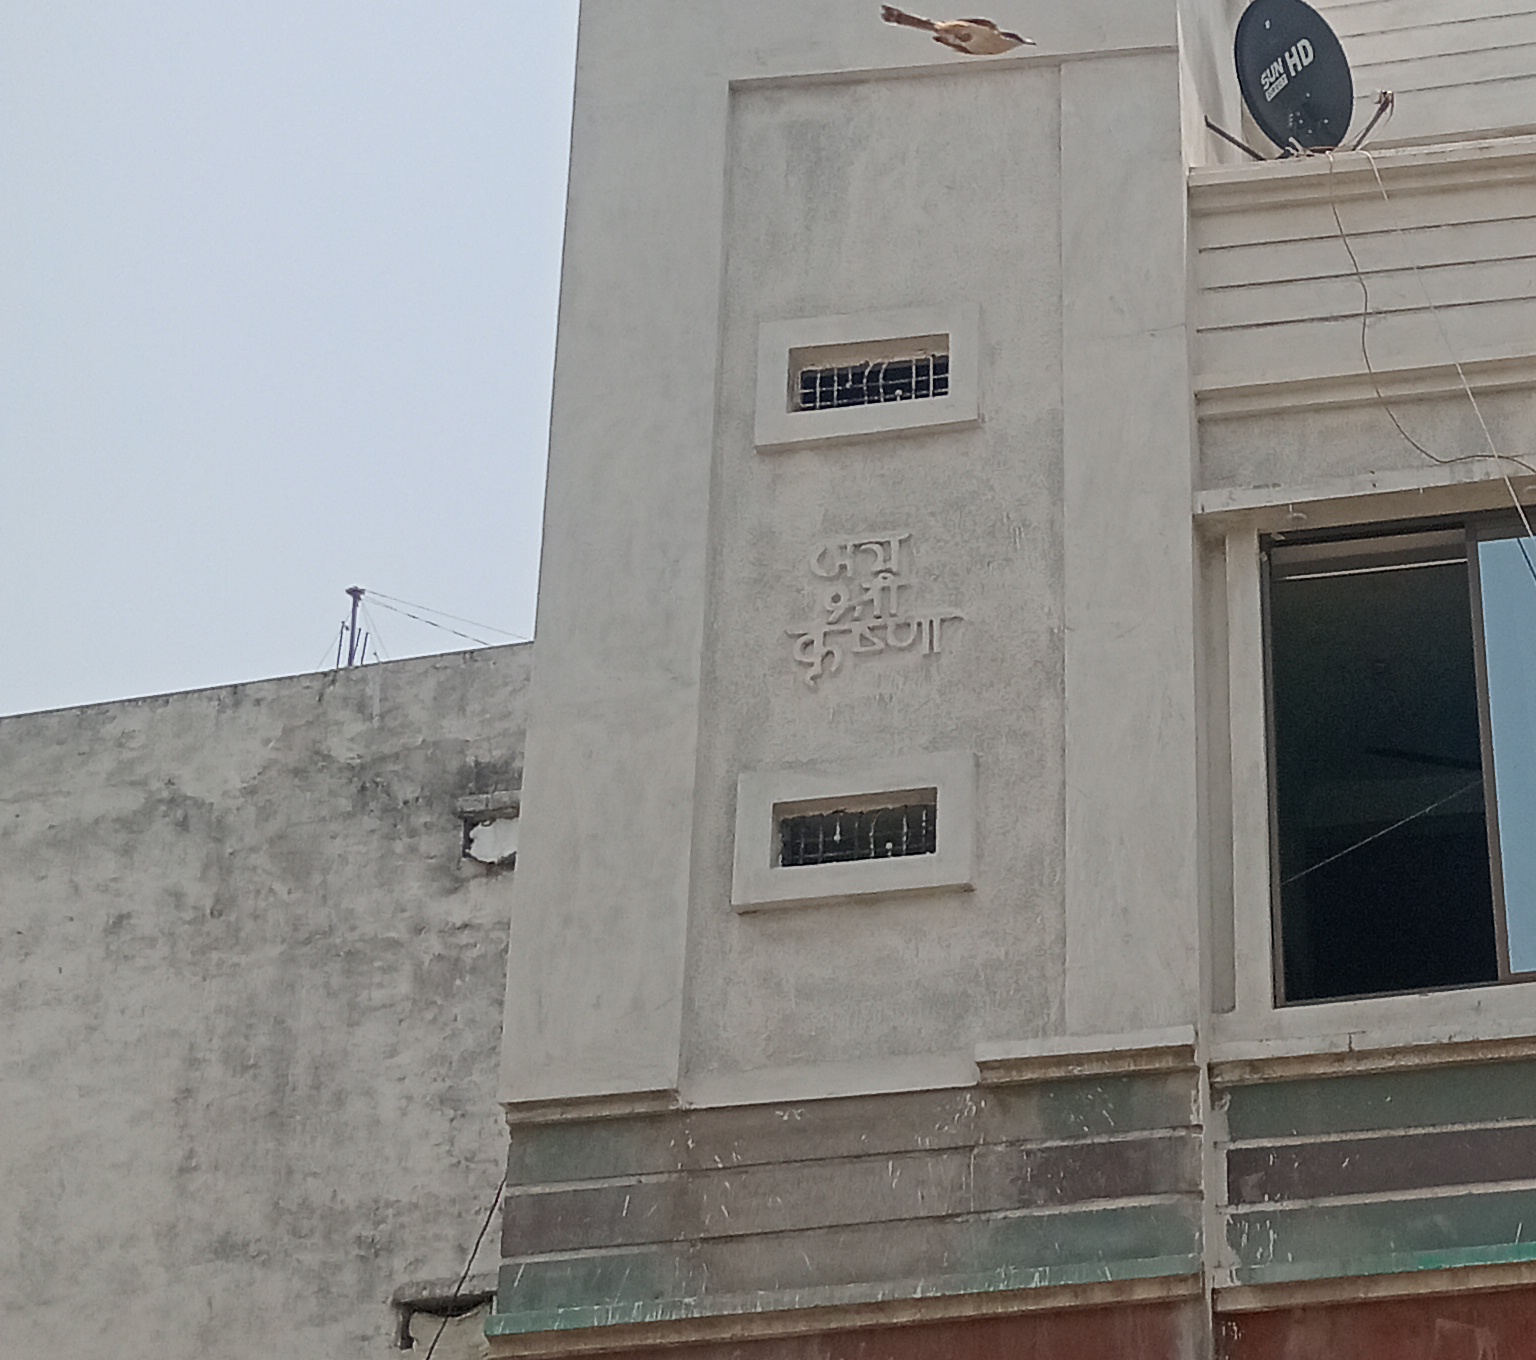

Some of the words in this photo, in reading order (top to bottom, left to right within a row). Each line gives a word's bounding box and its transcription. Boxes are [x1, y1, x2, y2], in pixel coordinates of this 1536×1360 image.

[1261, 57, 1285, 90] SUN
[1284, 38, 1314, 77] HD
[808, 533, 913, 578] जय
[822, 570, 913, 626] श्री
